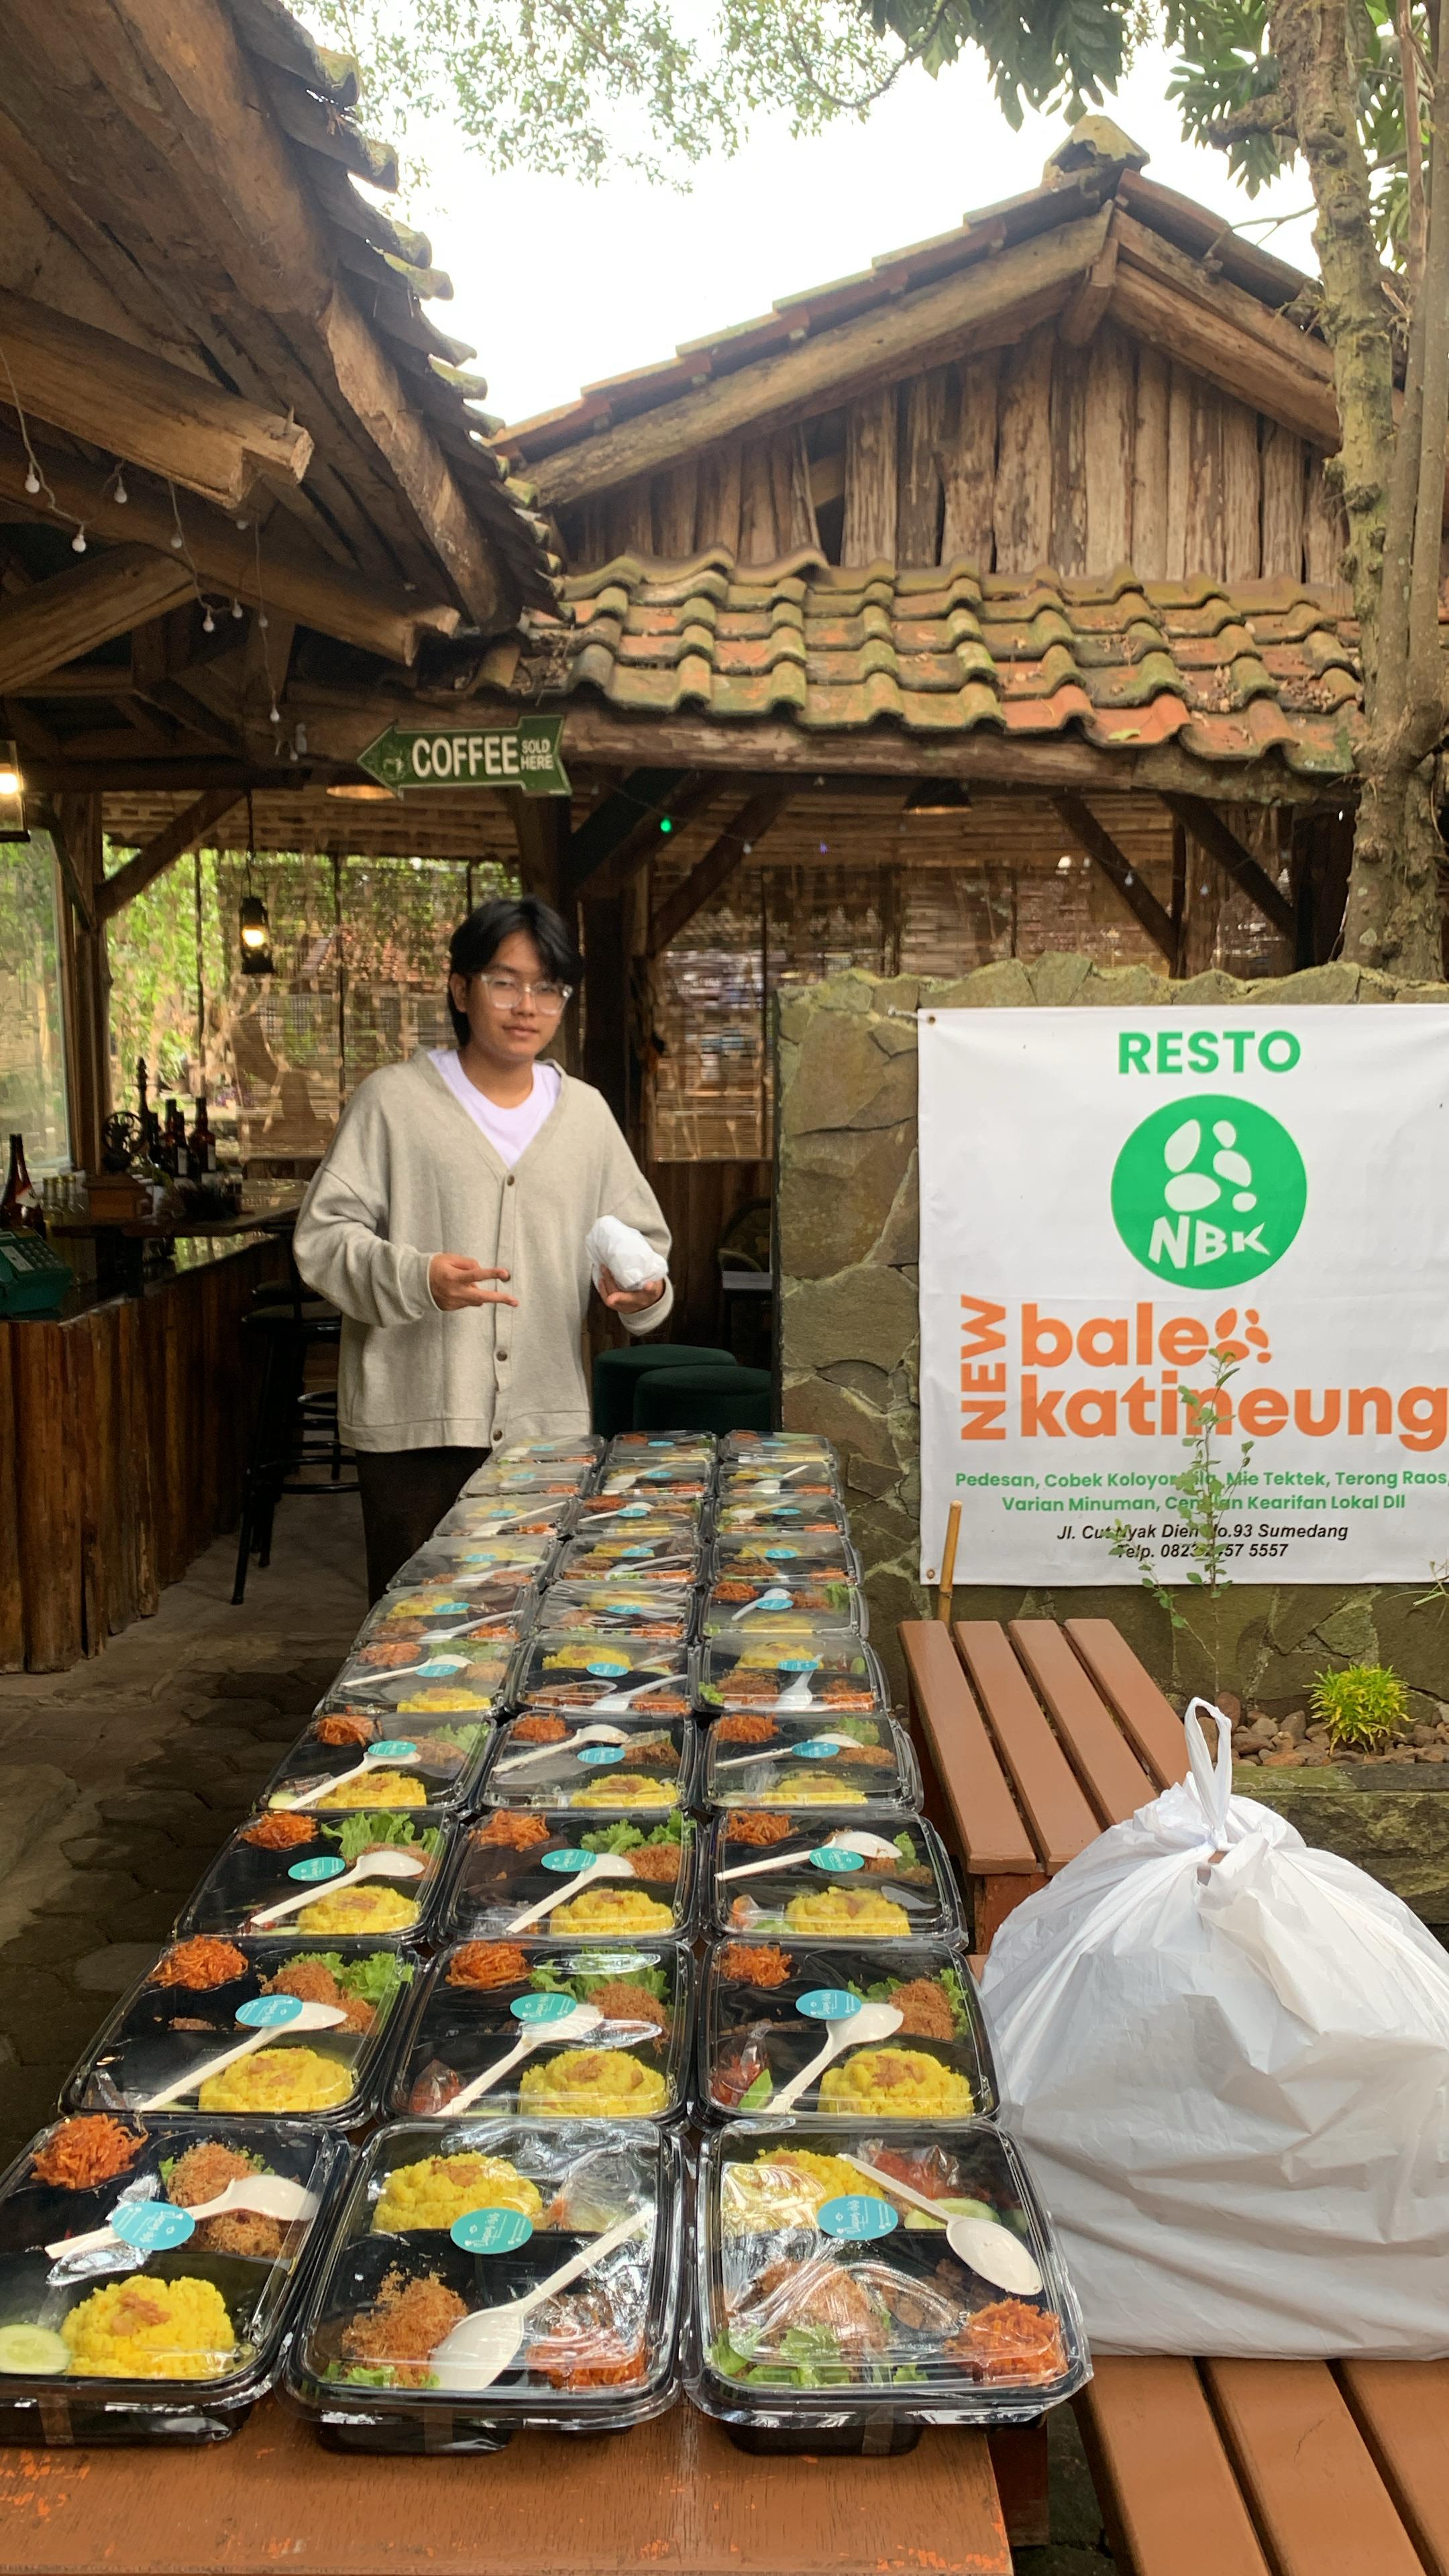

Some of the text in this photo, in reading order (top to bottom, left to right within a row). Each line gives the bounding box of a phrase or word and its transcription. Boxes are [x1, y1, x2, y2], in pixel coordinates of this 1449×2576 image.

[412, 735, 520, 777] COFFEE
[521, 739, 550, 753] SOLD
[521, 755, 553, 770] HERE
[1118, 1030, 1301, 1074] RESTO
[1148, 1214, 1271, 1269] NBK
[1021, 1301, 1210, 1368] bale
[961, 1294, 1006, 1440] NEW
[1020, 1370, 1448, 1452] katineung
[955, 1472, 1040, 1489] Pedesan,
[1044, 1472, 1103, 1487] Cobek
[1226, 1471, 1258, 1485] Mie
[1263, 1471, 1330, 1487] Tektek,
[1335, 1471, 1398, 1489] Terong
[1002, 1497, 1064, 1511] Varian
[1069, 1496, 1160, 1512] Minuman,
[1248, 1495, 1327, 1509] Kearifan
[1332, 1494, 1379, 1509] Lokal
[1057, 1525, 1075, 1540] Jl.
[1258, 1523, 1348, 1541] Sumedang
[1118, 1544, 1155, 1562] Telp.
[1249, 1544, 1289, 1557] 5557
